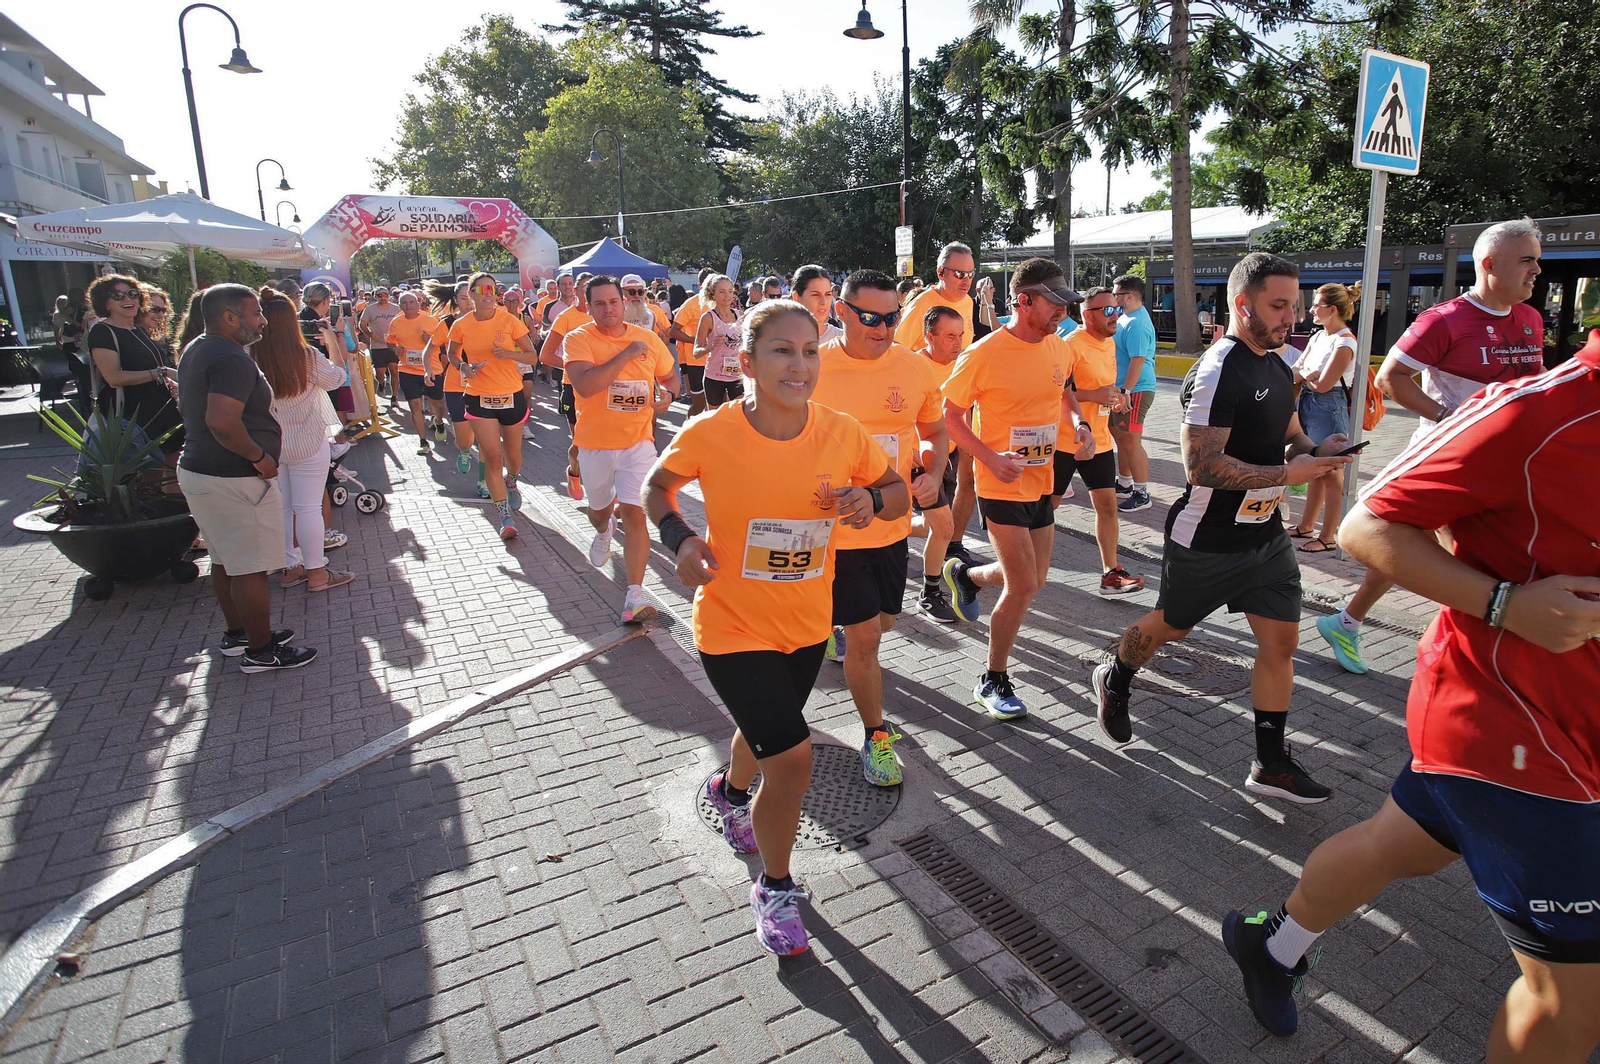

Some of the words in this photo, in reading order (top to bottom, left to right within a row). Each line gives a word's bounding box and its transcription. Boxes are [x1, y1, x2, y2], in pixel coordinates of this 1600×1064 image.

[398, 199, 438, 213] Carrera
[411, 213, 476, 223] SOLIDARIA
[33, 222, 102, 235] Cruzcampo
[400, 223, 417, 232] DE
[420, 224, 487, 233] PALMONES
[613, 395, 645, 405] 246
[1016, 444, 1052, 457] 416
[772, 527, 792, 535] SONRISA
[767, 550, 812, 568] 53
